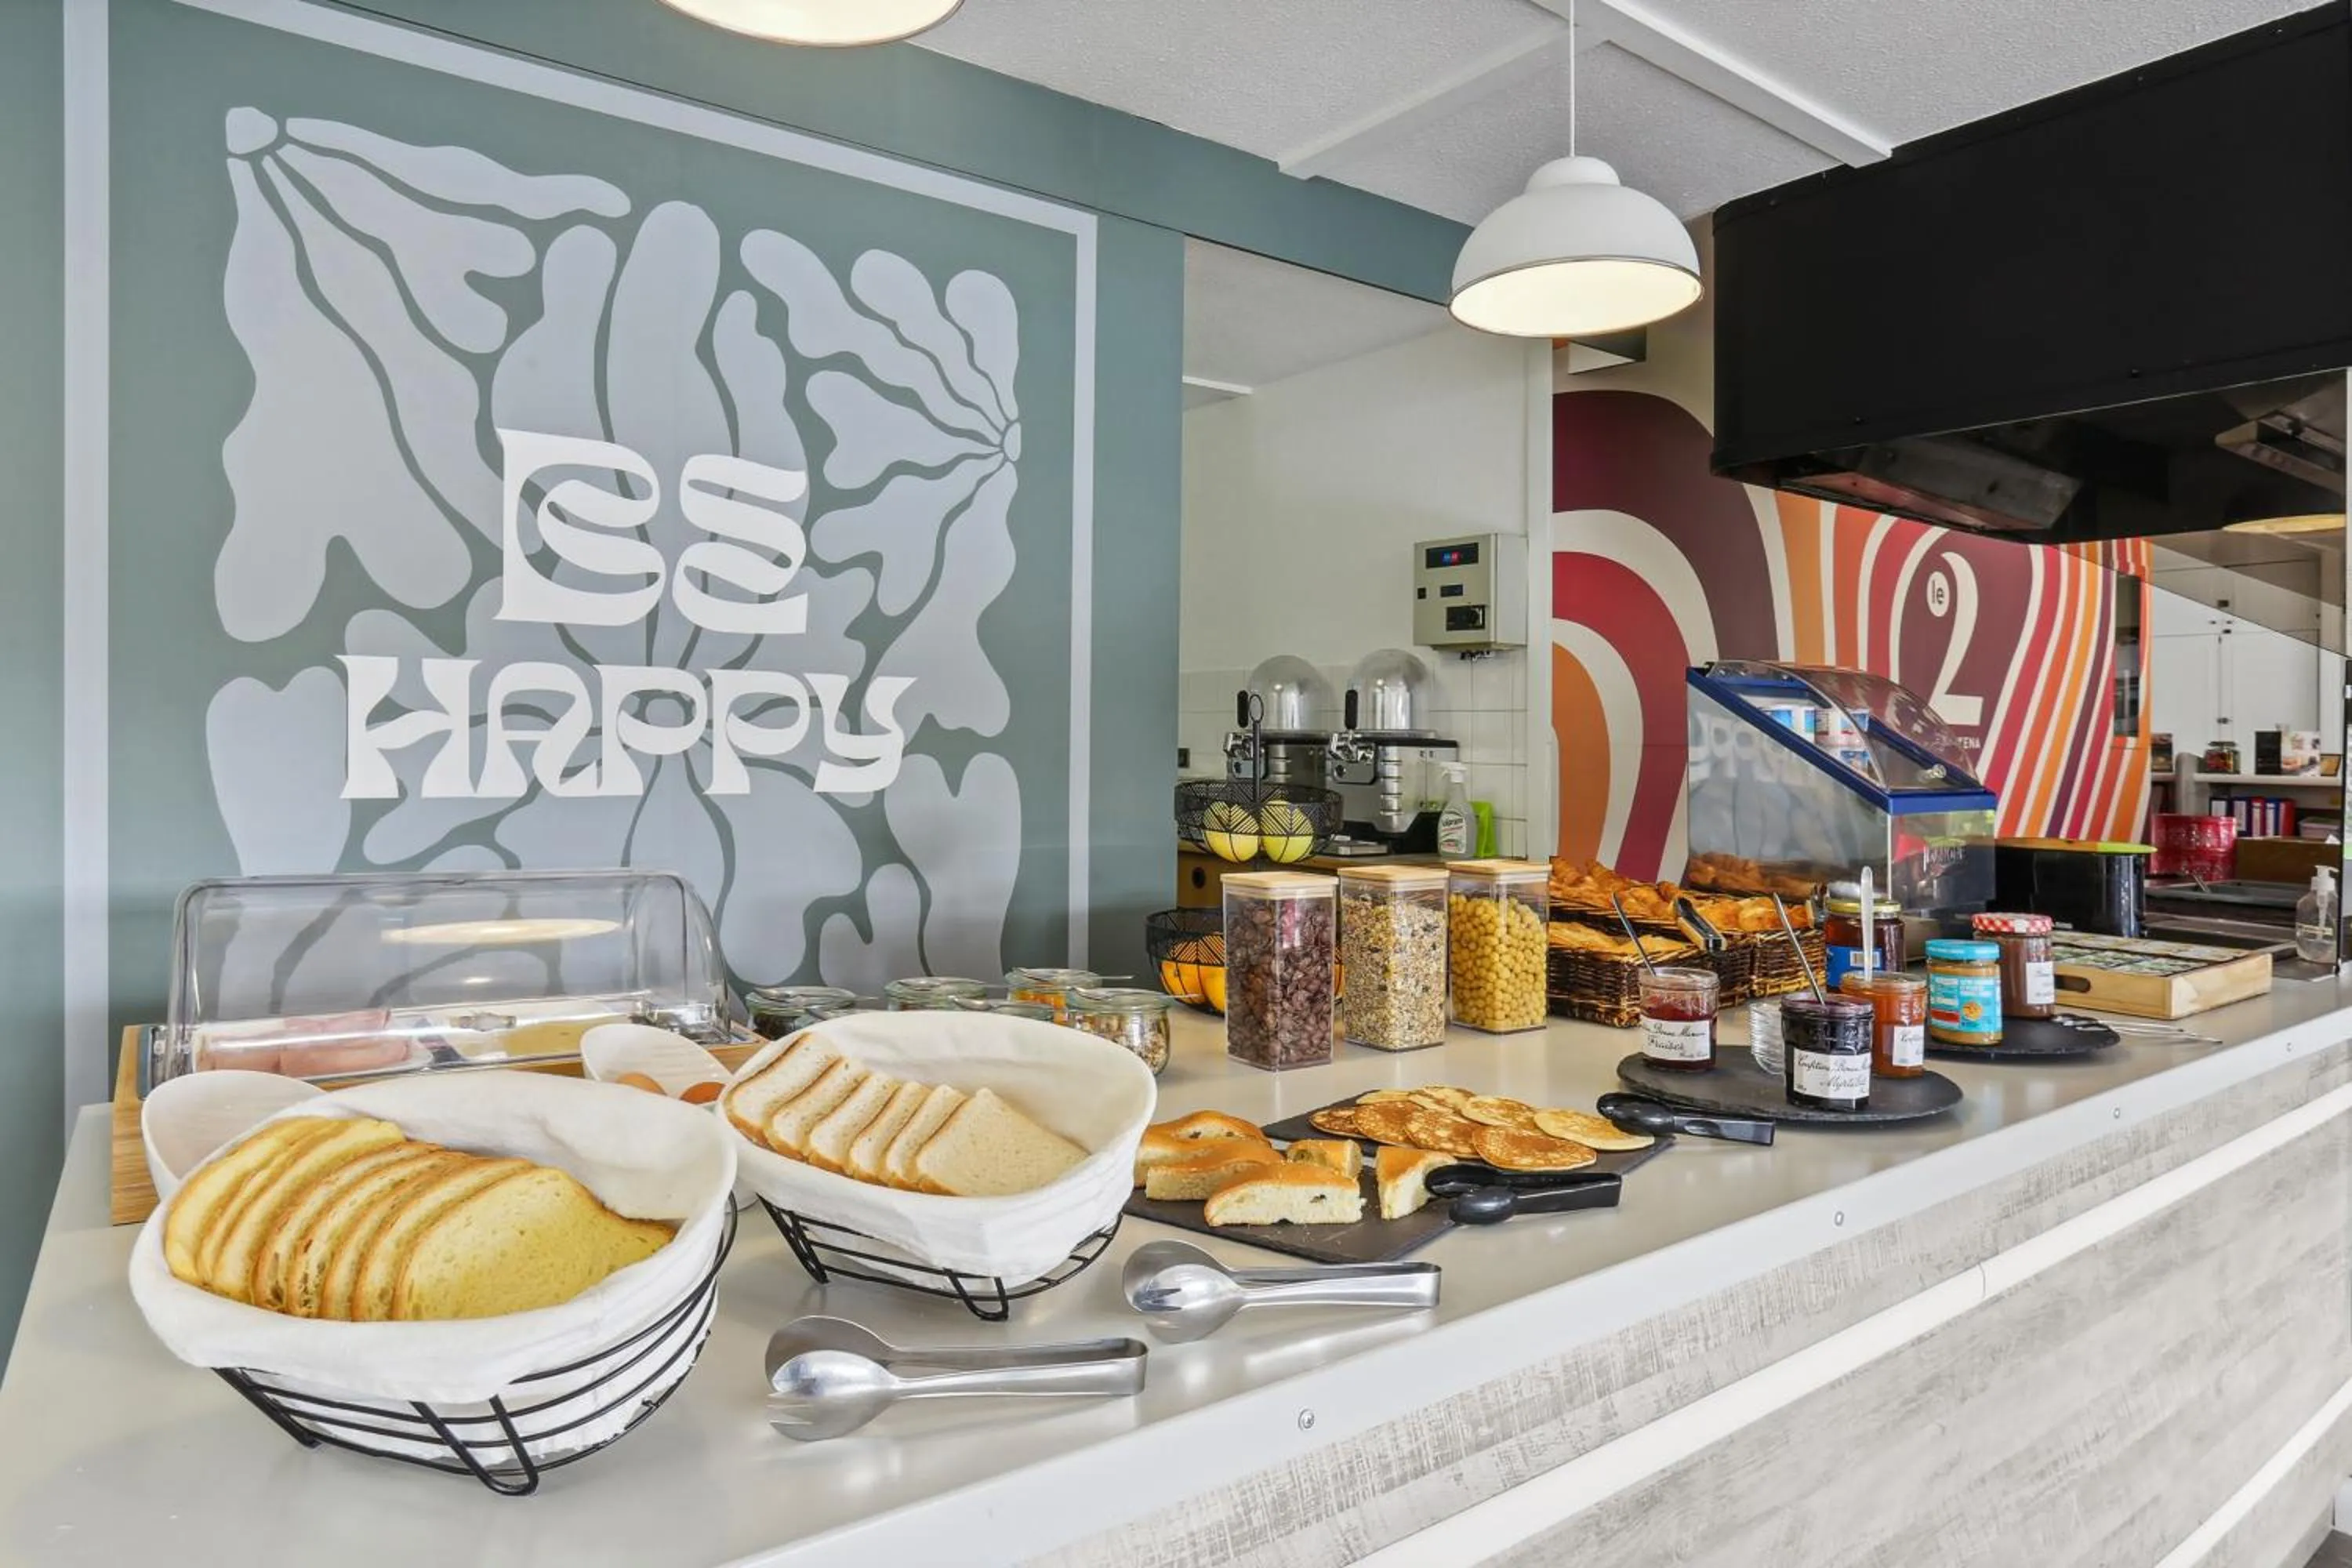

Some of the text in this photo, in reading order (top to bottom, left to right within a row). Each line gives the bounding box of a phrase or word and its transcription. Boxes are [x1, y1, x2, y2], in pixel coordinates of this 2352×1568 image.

[494, 427, 808, 634] BE
[1929, 551, 1984, 726] 2
[334, 655, 917, 799] HAPPY
